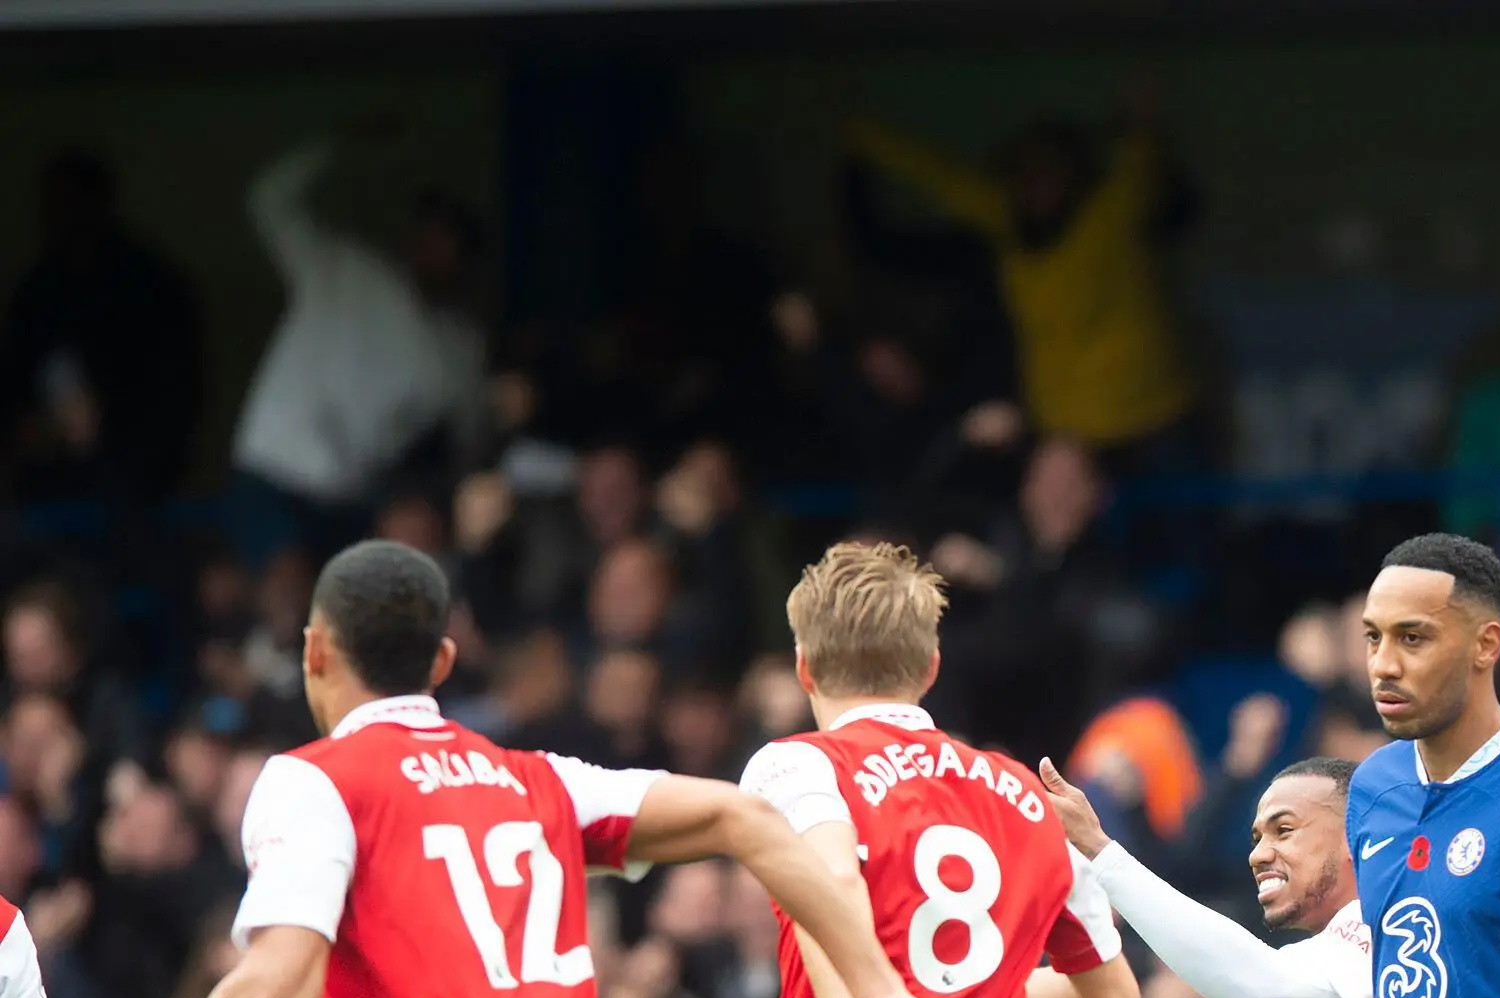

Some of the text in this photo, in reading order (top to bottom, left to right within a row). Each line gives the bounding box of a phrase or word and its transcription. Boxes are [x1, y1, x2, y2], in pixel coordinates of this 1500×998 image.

[853, 742, 1045, 823] ØDEGAARD
[422, 821, 594, 989] 12
[908, 824, 1004, 994] 8
